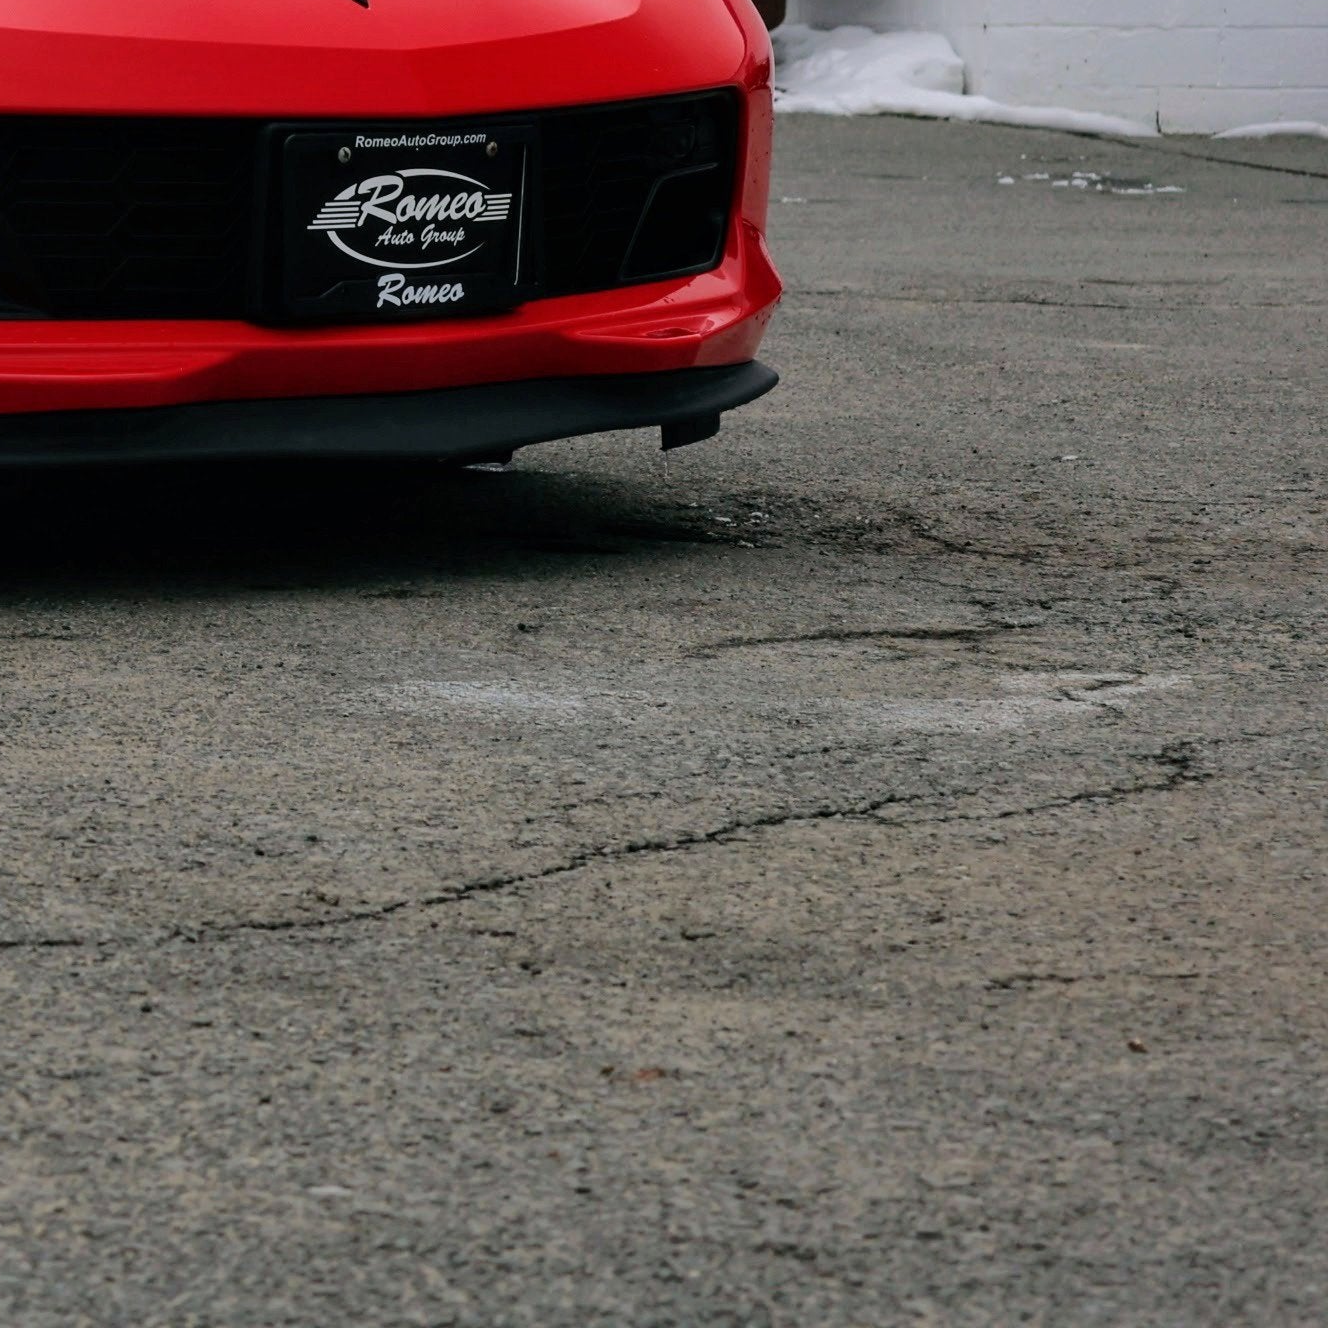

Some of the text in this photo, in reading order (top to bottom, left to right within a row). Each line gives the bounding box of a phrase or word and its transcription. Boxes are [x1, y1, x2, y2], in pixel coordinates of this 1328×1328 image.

[355, 133, 486, 148] RomeoAutoGroup.com
[358, 175, 486, 227] Romeo
[375, 224, 465, 249] Auto Group
[376, 273, 464, 308] Romeo
